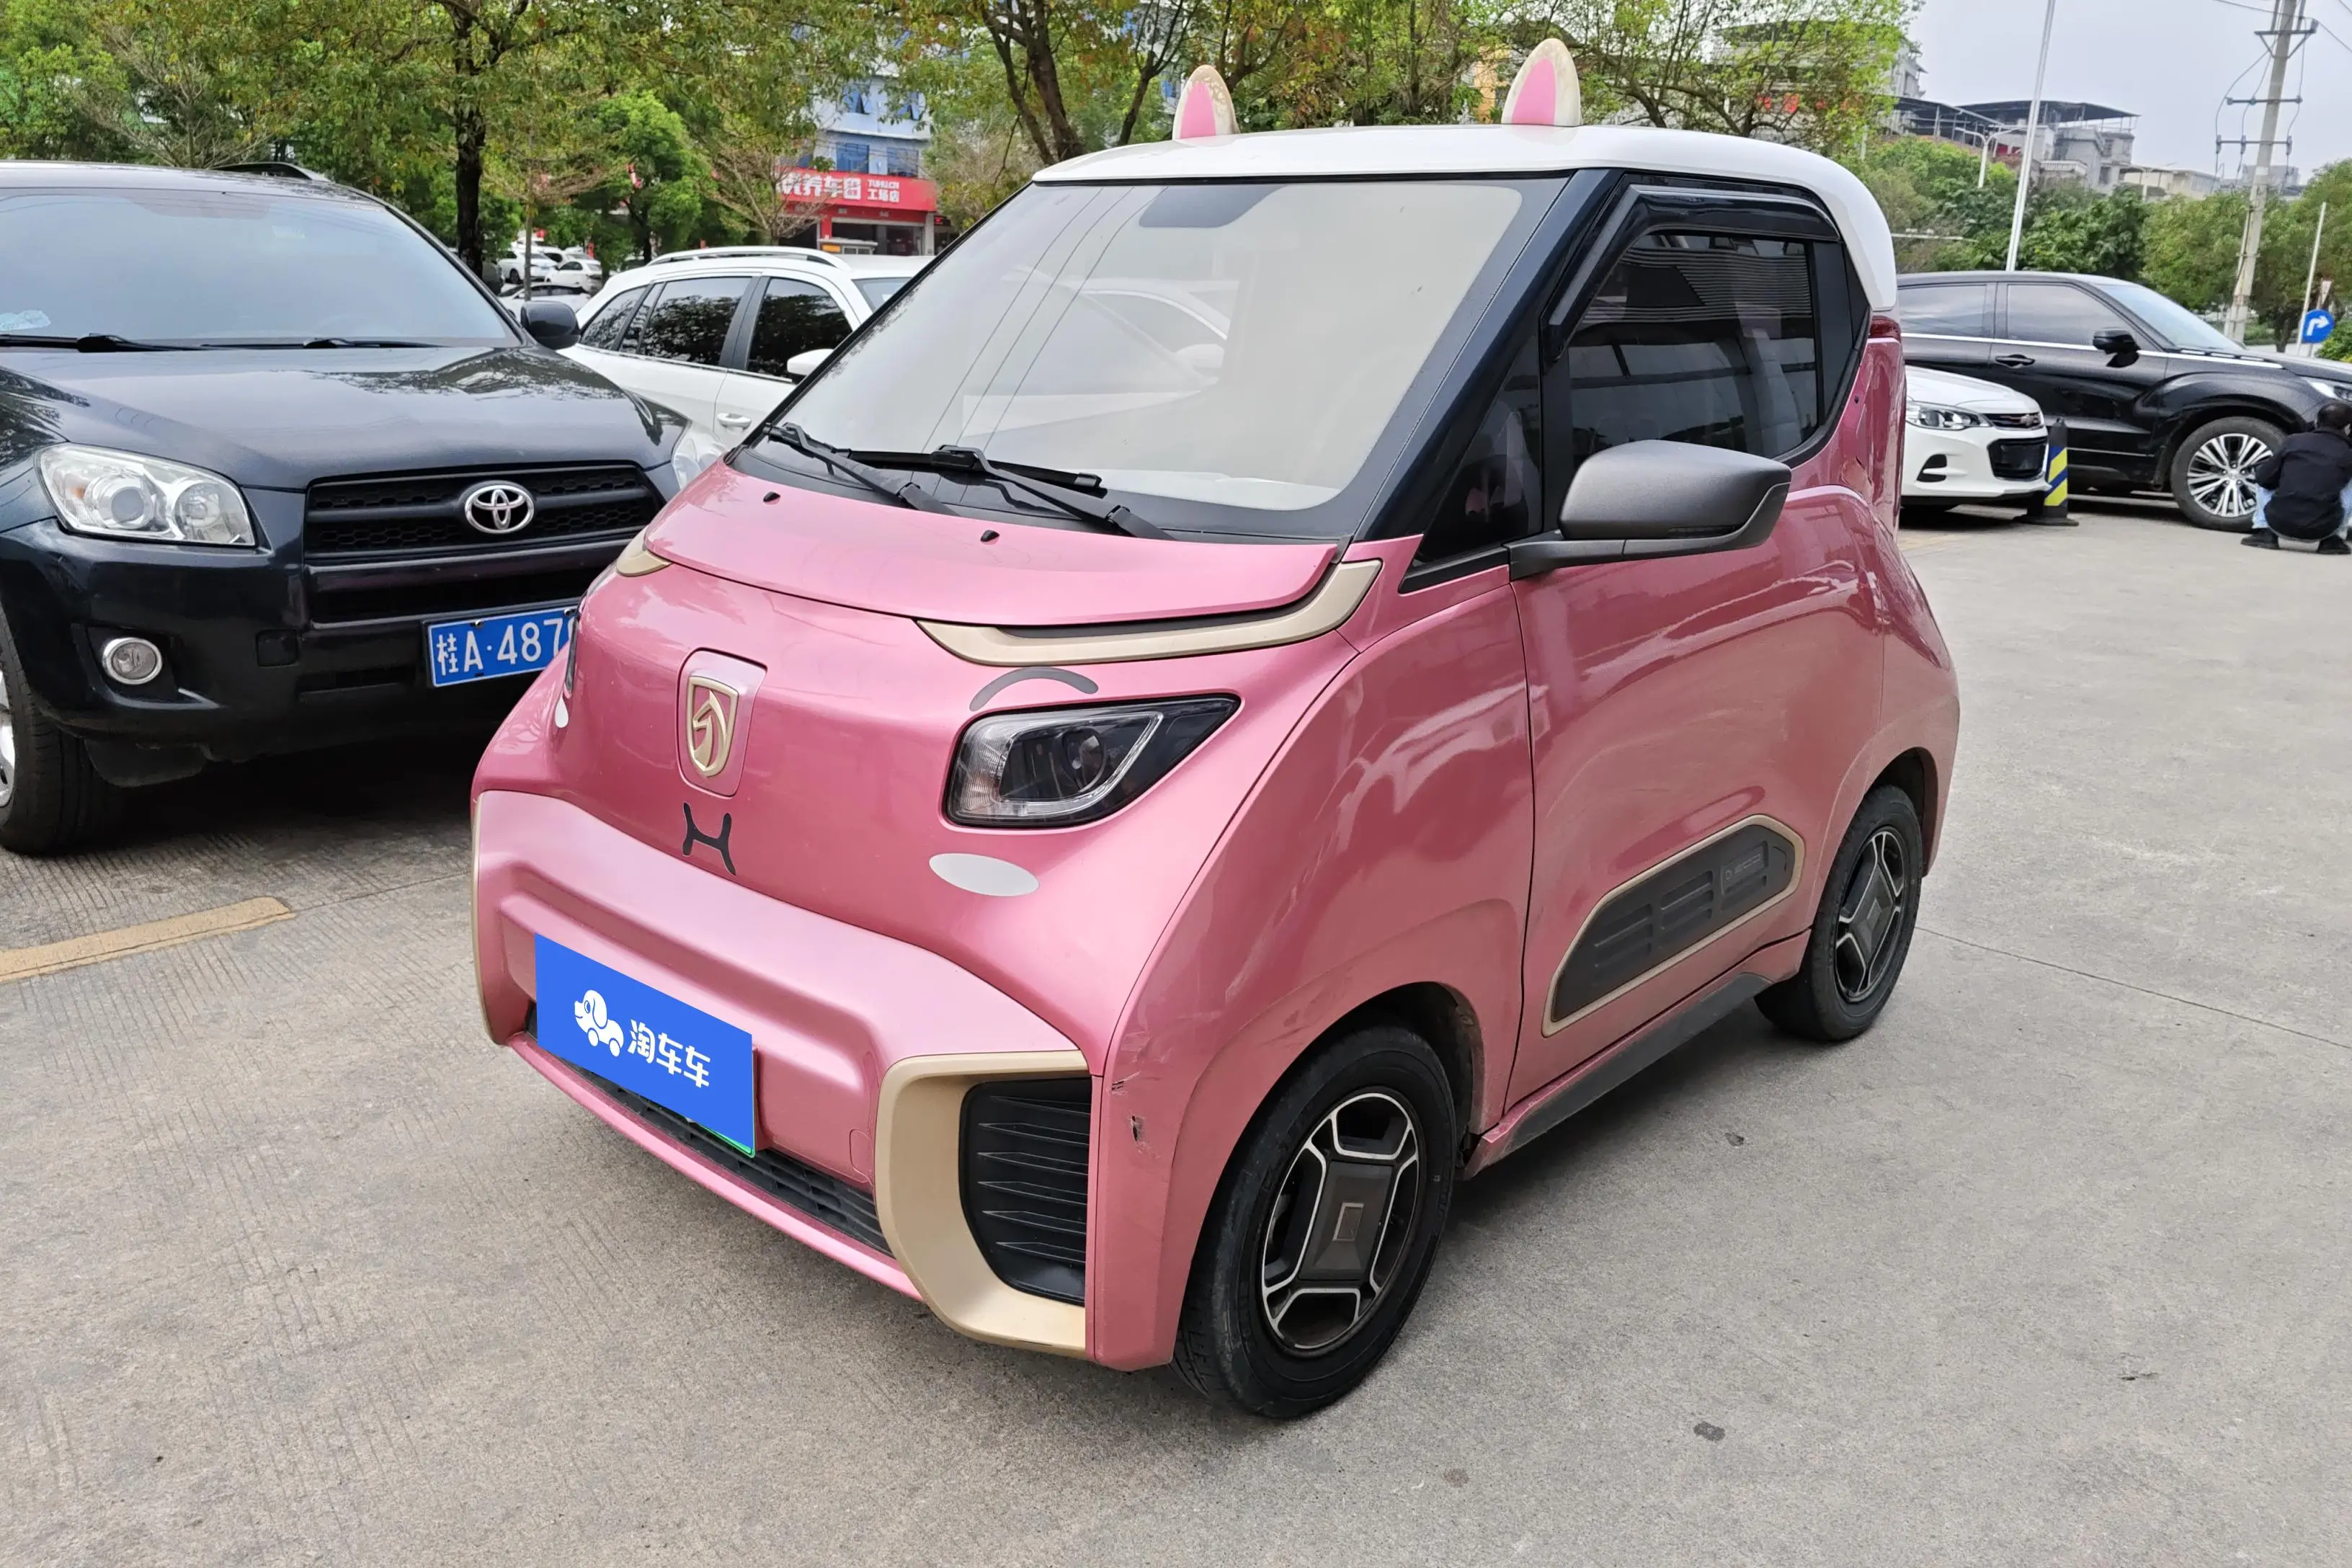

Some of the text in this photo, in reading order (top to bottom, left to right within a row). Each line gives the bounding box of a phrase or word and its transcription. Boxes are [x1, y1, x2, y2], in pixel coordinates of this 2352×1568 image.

[867, 188, 900, 203] 工场店
[436, 618, 574, 676] 桂A·487
